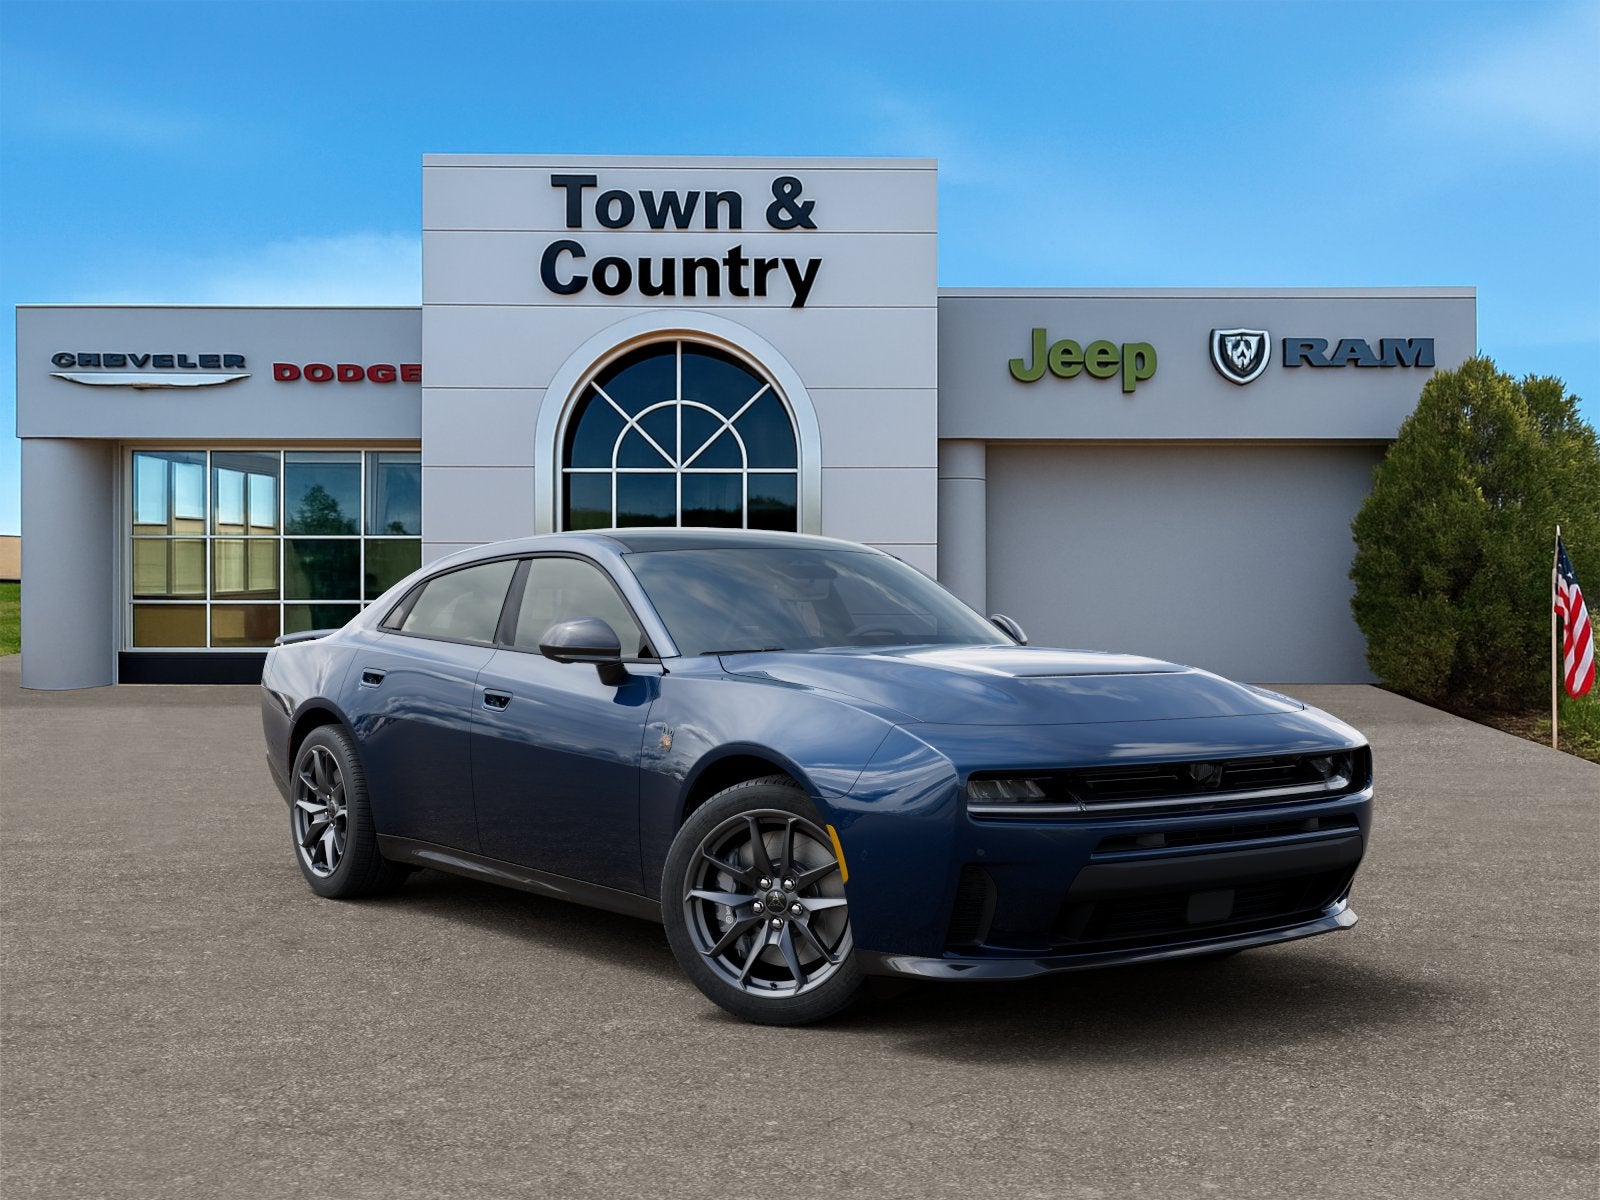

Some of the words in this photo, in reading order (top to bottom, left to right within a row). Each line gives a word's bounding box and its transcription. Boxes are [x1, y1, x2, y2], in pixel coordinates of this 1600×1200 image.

[551, 174, 742, 229] Town
[766, 176, 818, 229] &
[540, 240, 822, 308] Country
[273, 363, 422, 383] DODGE
[1009, 328, 1157, 393] Jeep
[1283, 338, 1435, 368] RAM
